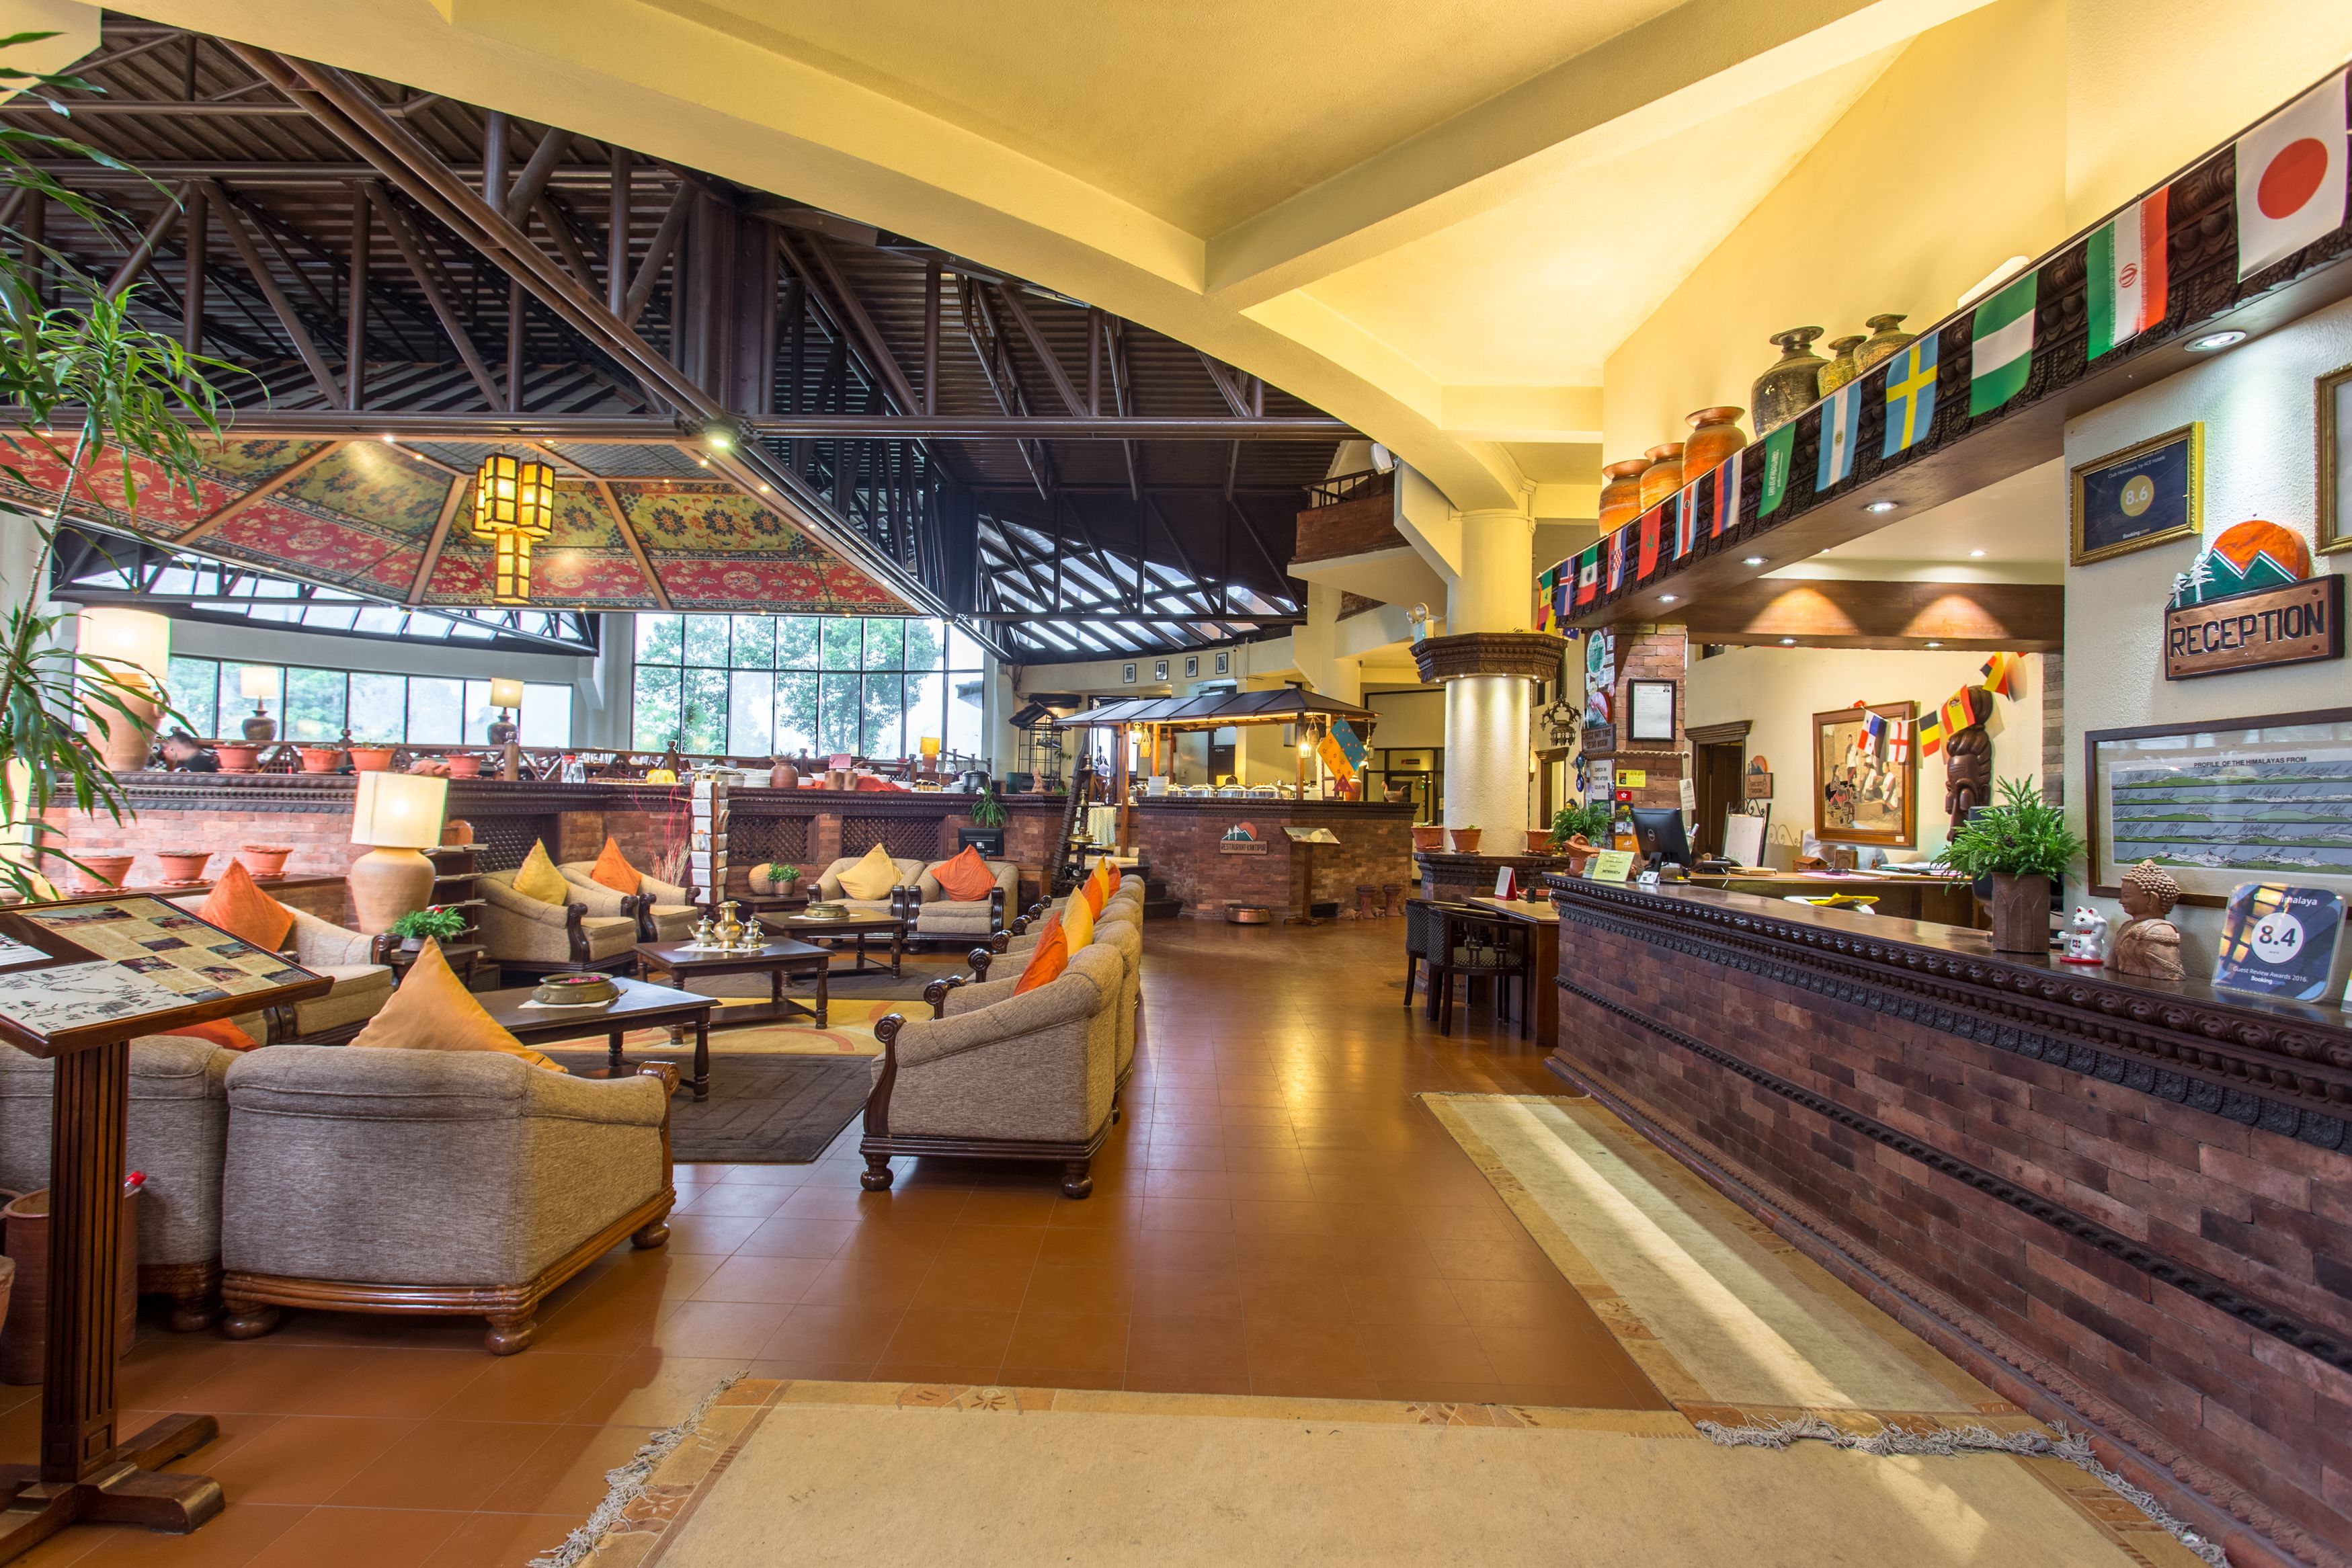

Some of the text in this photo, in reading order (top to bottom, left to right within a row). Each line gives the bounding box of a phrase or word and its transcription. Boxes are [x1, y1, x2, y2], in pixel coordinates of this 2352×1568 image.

[2125, 485, 2148, 505] 8.6
[2122, 528, 2151, 539] Booking.com
[2170, 601, 2324, 659] RECEPTION
[2246, 757, 2285, 766] HIMALAYAS
[2259, 925, 2296, 947] 8.4
[2232, 966, 2248, 974] Guest
[2249, 968, 2269, 977] Review
[2269, 972, 2291, 980] Awards
[2250, 975, 2285, 985] Booking.com
